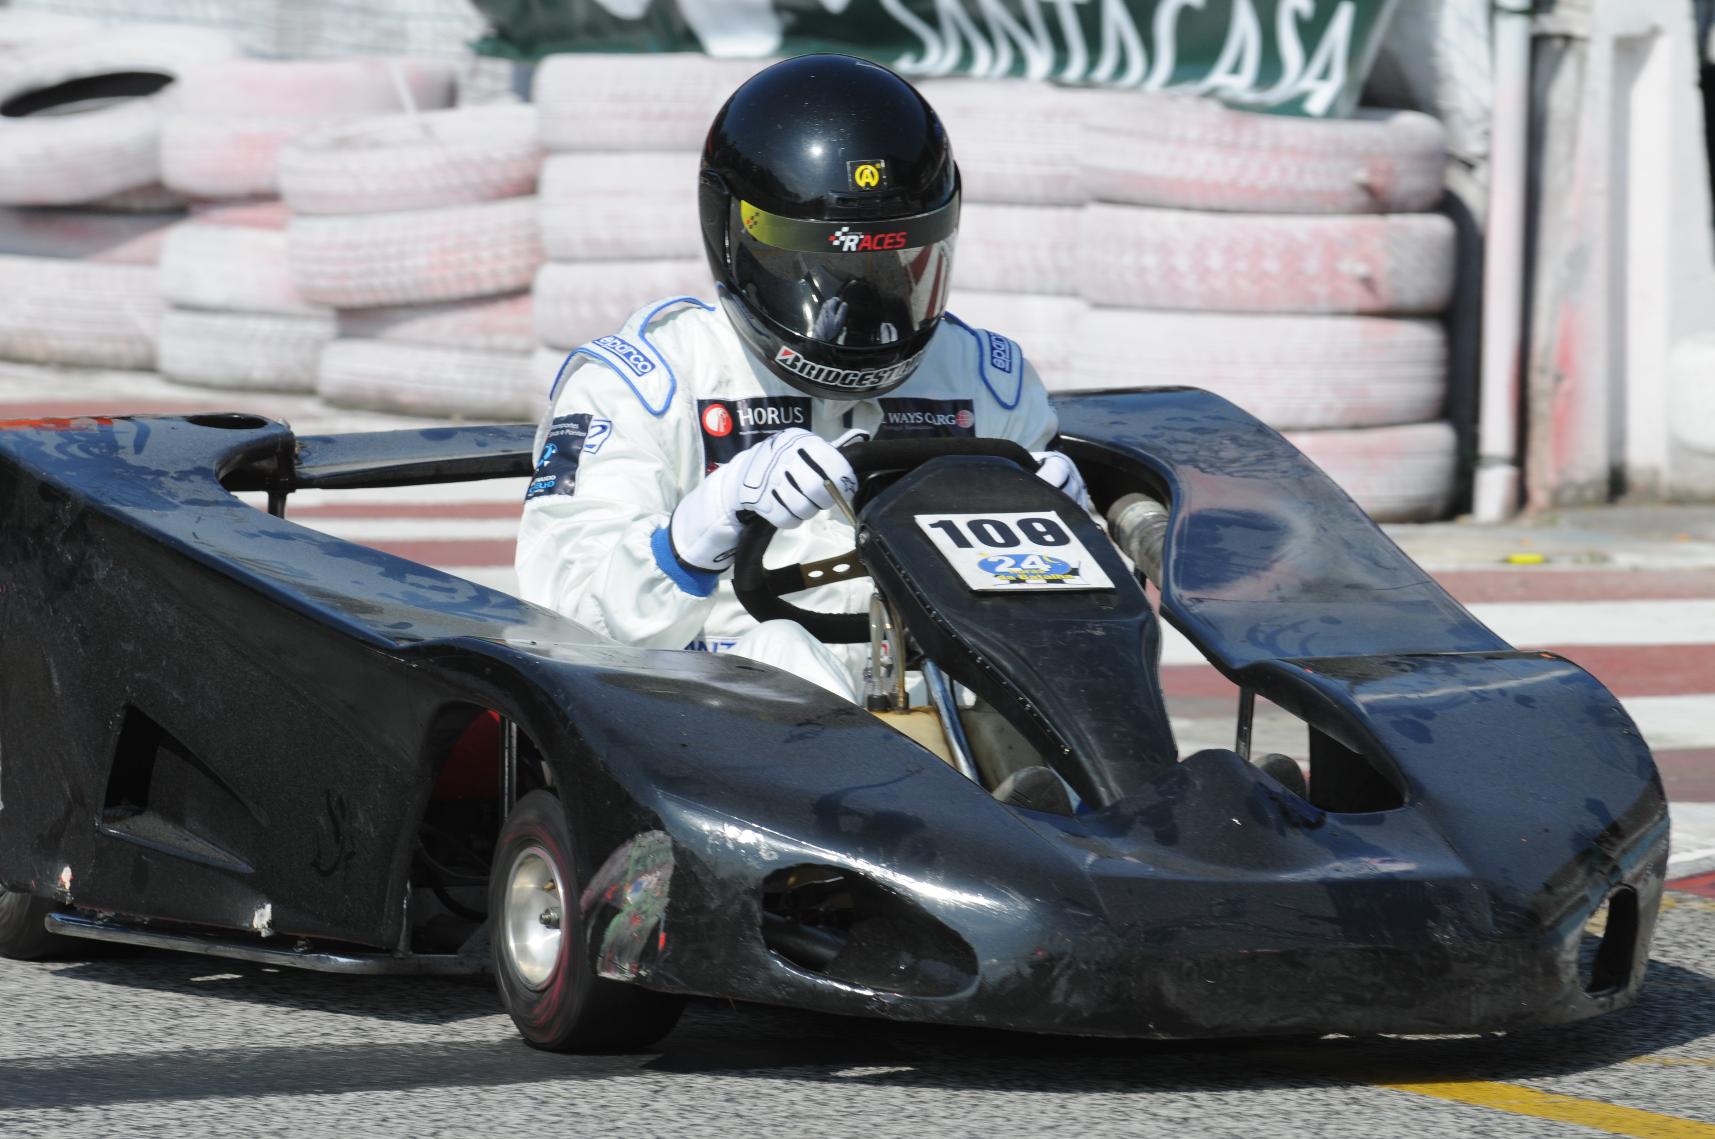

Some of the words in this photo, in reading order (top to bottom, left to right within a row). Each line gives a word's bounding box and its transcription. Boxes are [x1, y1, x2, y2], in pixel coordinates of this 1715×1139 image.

[842, 231, 908, 252] RACES
[737, 406, 804, 427] HORUS
[987, 554, 1052, 573] 24
